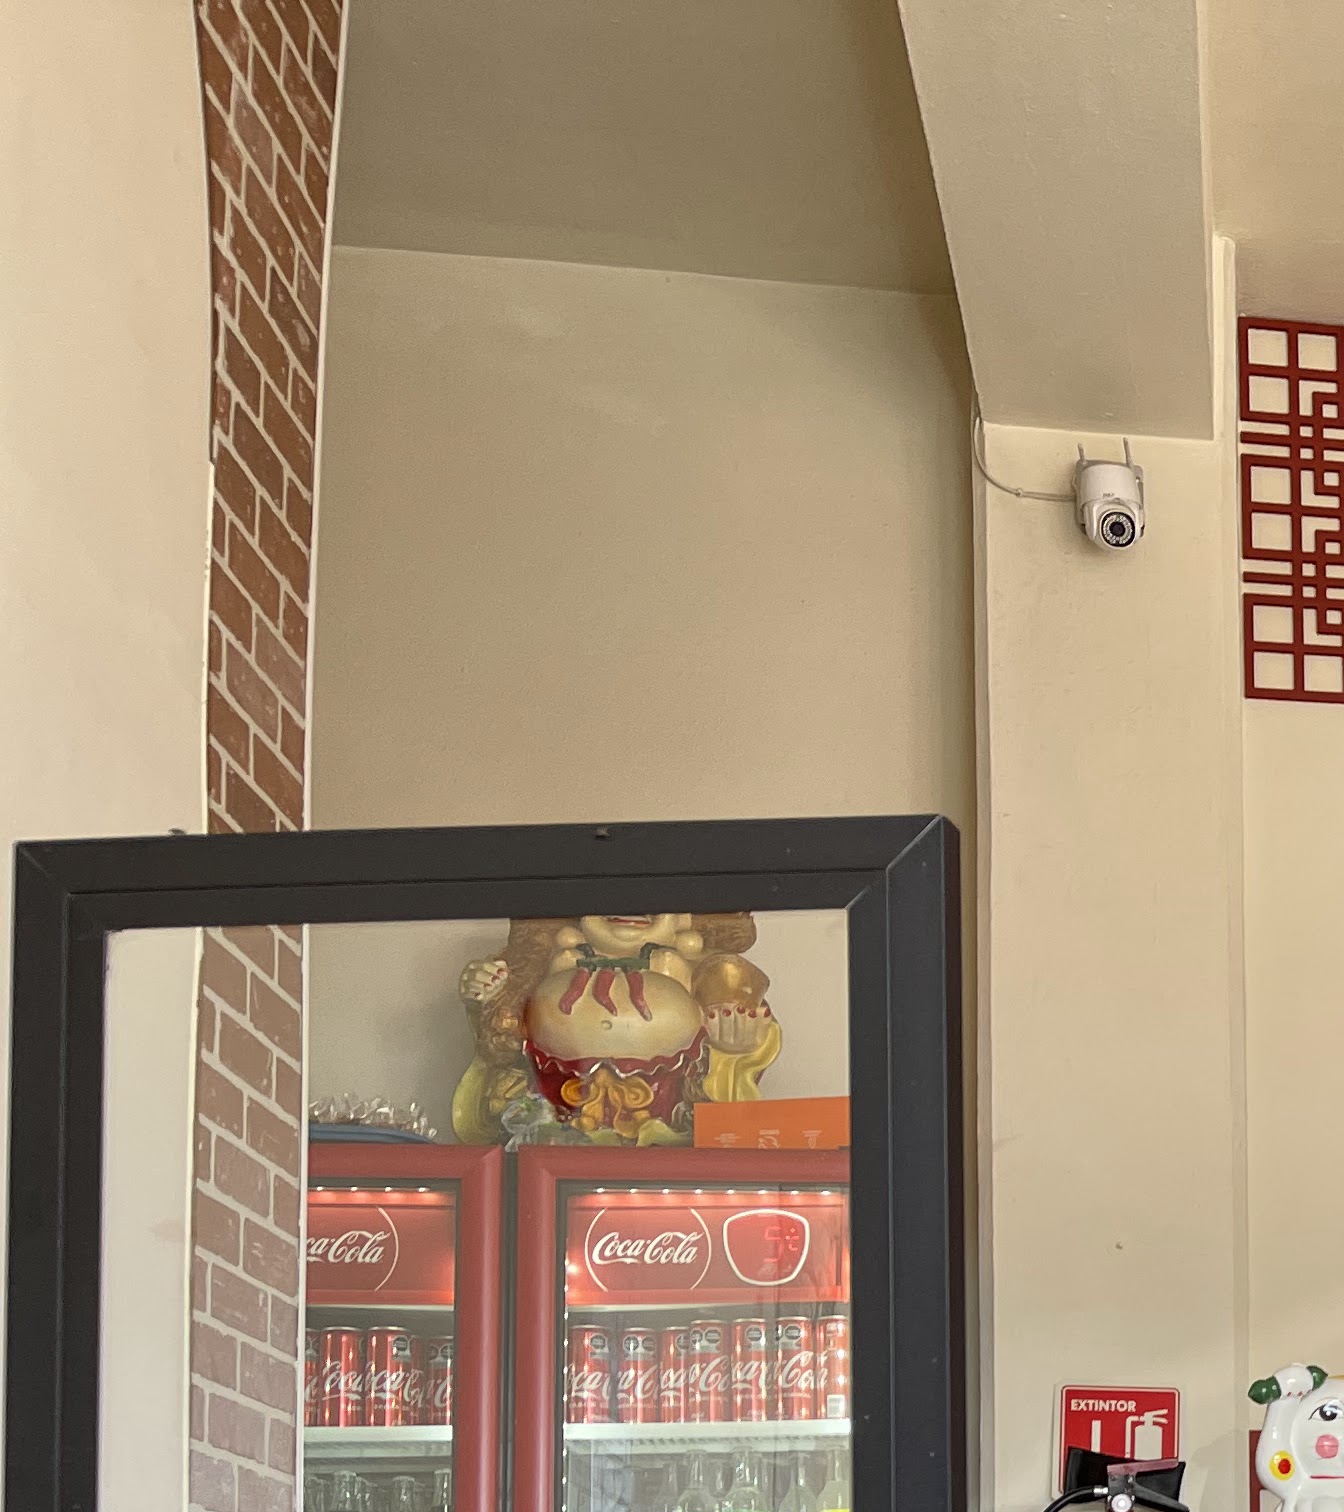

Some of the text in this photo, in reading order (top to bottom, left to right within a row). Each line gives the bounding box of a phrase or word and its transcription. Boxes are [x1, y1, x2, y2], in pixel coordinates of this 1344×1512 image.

[306, 1230, 391, 1264] ca-Cola
[591, 1231, 705, 1265] Coca-Cola
[1070, 1399, 1136, 1413] EXTINTOR
